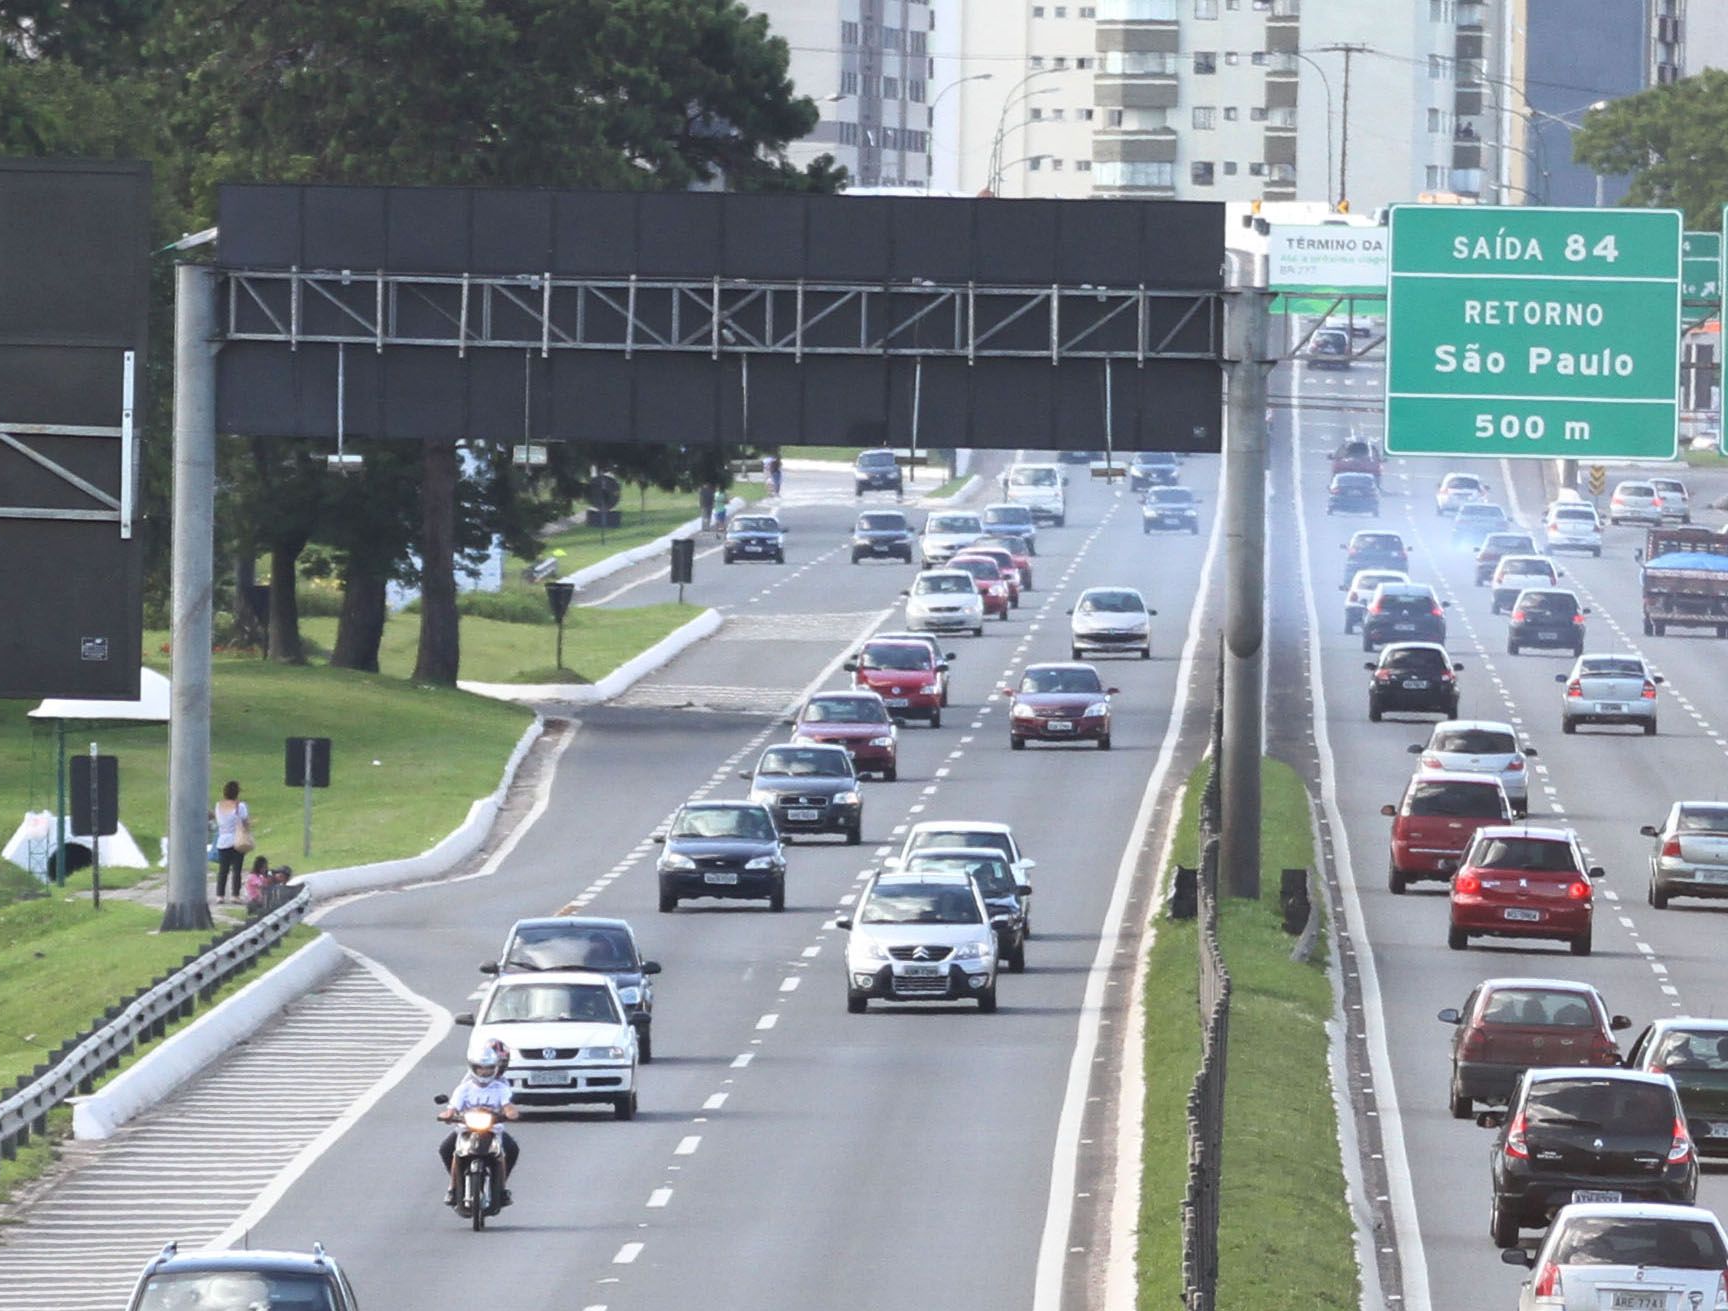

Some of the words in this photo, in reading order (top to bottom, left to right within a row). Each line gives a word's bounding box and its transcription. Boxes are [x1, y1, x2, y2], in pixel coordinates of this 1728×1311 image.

[1286, 236, 1357, 251] TÉRMINO
[1362, 240, 1383, 251] DA
[1453, 228, 1542, 262] SAÍDA
[1564, 235, 1619, 263] 84
[1464, 301, 1604, 328] RETORNO
[1434, 343, 1505, 376] São
[1528, 347, 1634, 378] Paulo
[1474, 415, 1545, 441] 500
[1565, 419, 1591, 442] m
